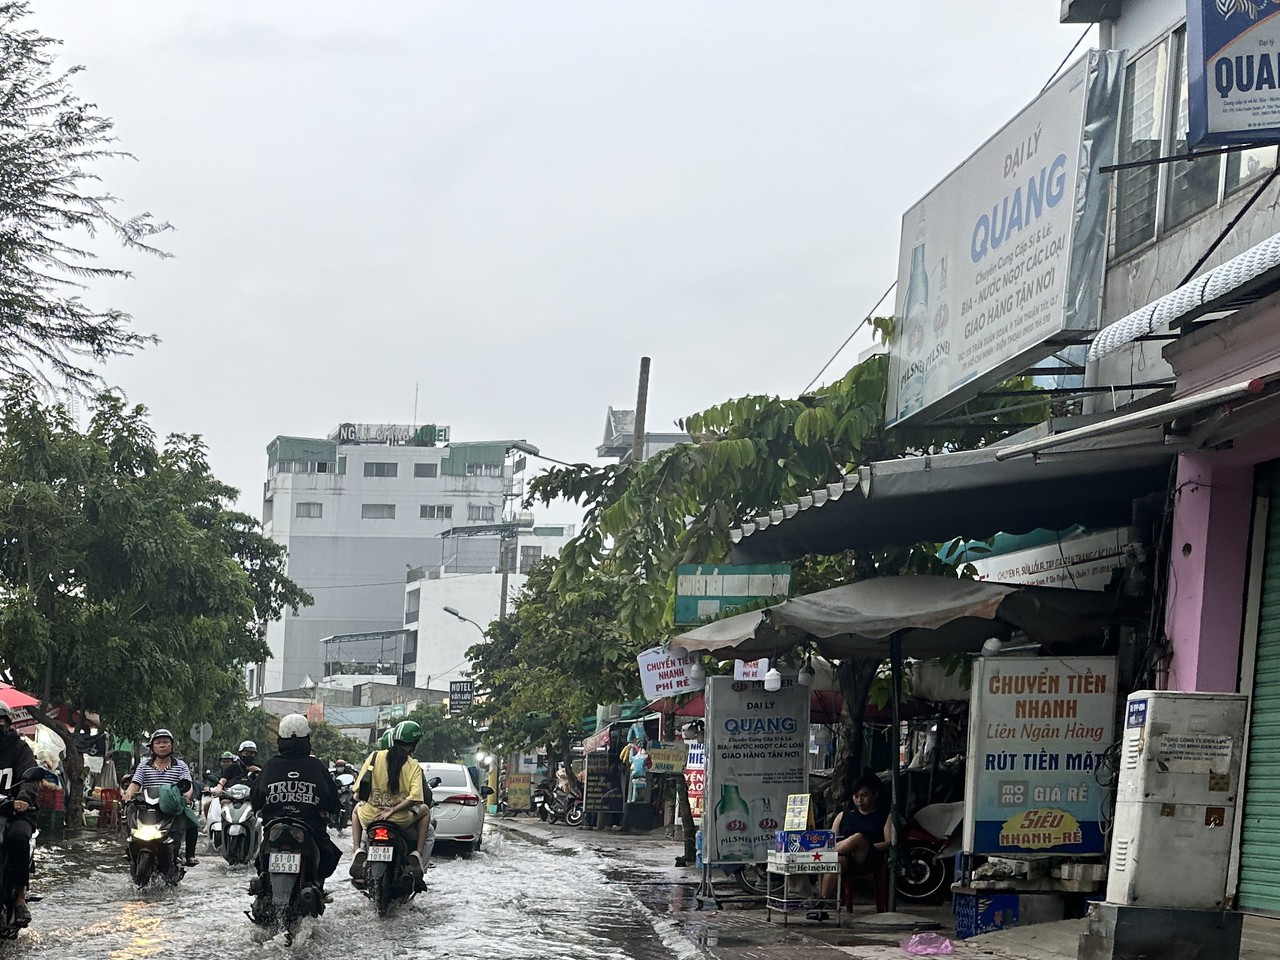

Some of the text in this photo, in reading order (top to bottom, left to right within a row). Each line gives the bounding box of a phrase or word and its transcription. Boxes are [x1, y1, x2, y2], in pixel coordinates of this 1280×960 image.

[1215, 52, 1280, 98] QUA
[1003, 120, 1042, 179] ĐẠI LÝ
[970, 152, 1067, 264] QUANG
[997, 251, 1014, 270] Cung
[961, 296, 973, 317] BIA
[978, 275, 1002, 305] NƯỚC
[1002, 260, 1025, 286] NGỌT
[1026, 247, 1044, 273] CÁC
[1044, 233, 1065, 261] LOẠI
[964, 312, 986, 340] GIAO
[986, 294, 1014, 327] HÀNG
[1015, 281, 1034, 310] TẬN
[1035, 266, 1055, 296] NƠI
[339, 423, 370, 440] NGÂN
[646, 655, 676, 672] CHUYỂN
[658, 667, 685, 681] NHANH
[989, 667, 1107, 694] CHUYỂN TIỀN
[451, 682, 471, 692] HOTEL
[655, 675, 690, 691] PHÍ RẺ
[746, 702, 762, 712] ĐẠI
[1015, 699, 1077, 719] NHANH
[723, 717, 796, 733] QUANG
[986, 722, 1104, 743] Liên Ngân Hàng
[721, 750, 799, 760] GIAO HÀNG TẬN NƠI
[985, 748, 1106, 774] RÚT TIỀN MẶT
[267, 780, 317, 795] TRUST
[1033, 783, 1061, 802] GIÁ
[1067, 783, 1089, 802] RẺ
[265, 792, 321, 806] YOURSELF
[753, 833, 776, 843] PILSN
[805, 834, 826, 843] Tiger
[797, 864, 837, 872] Heineken
